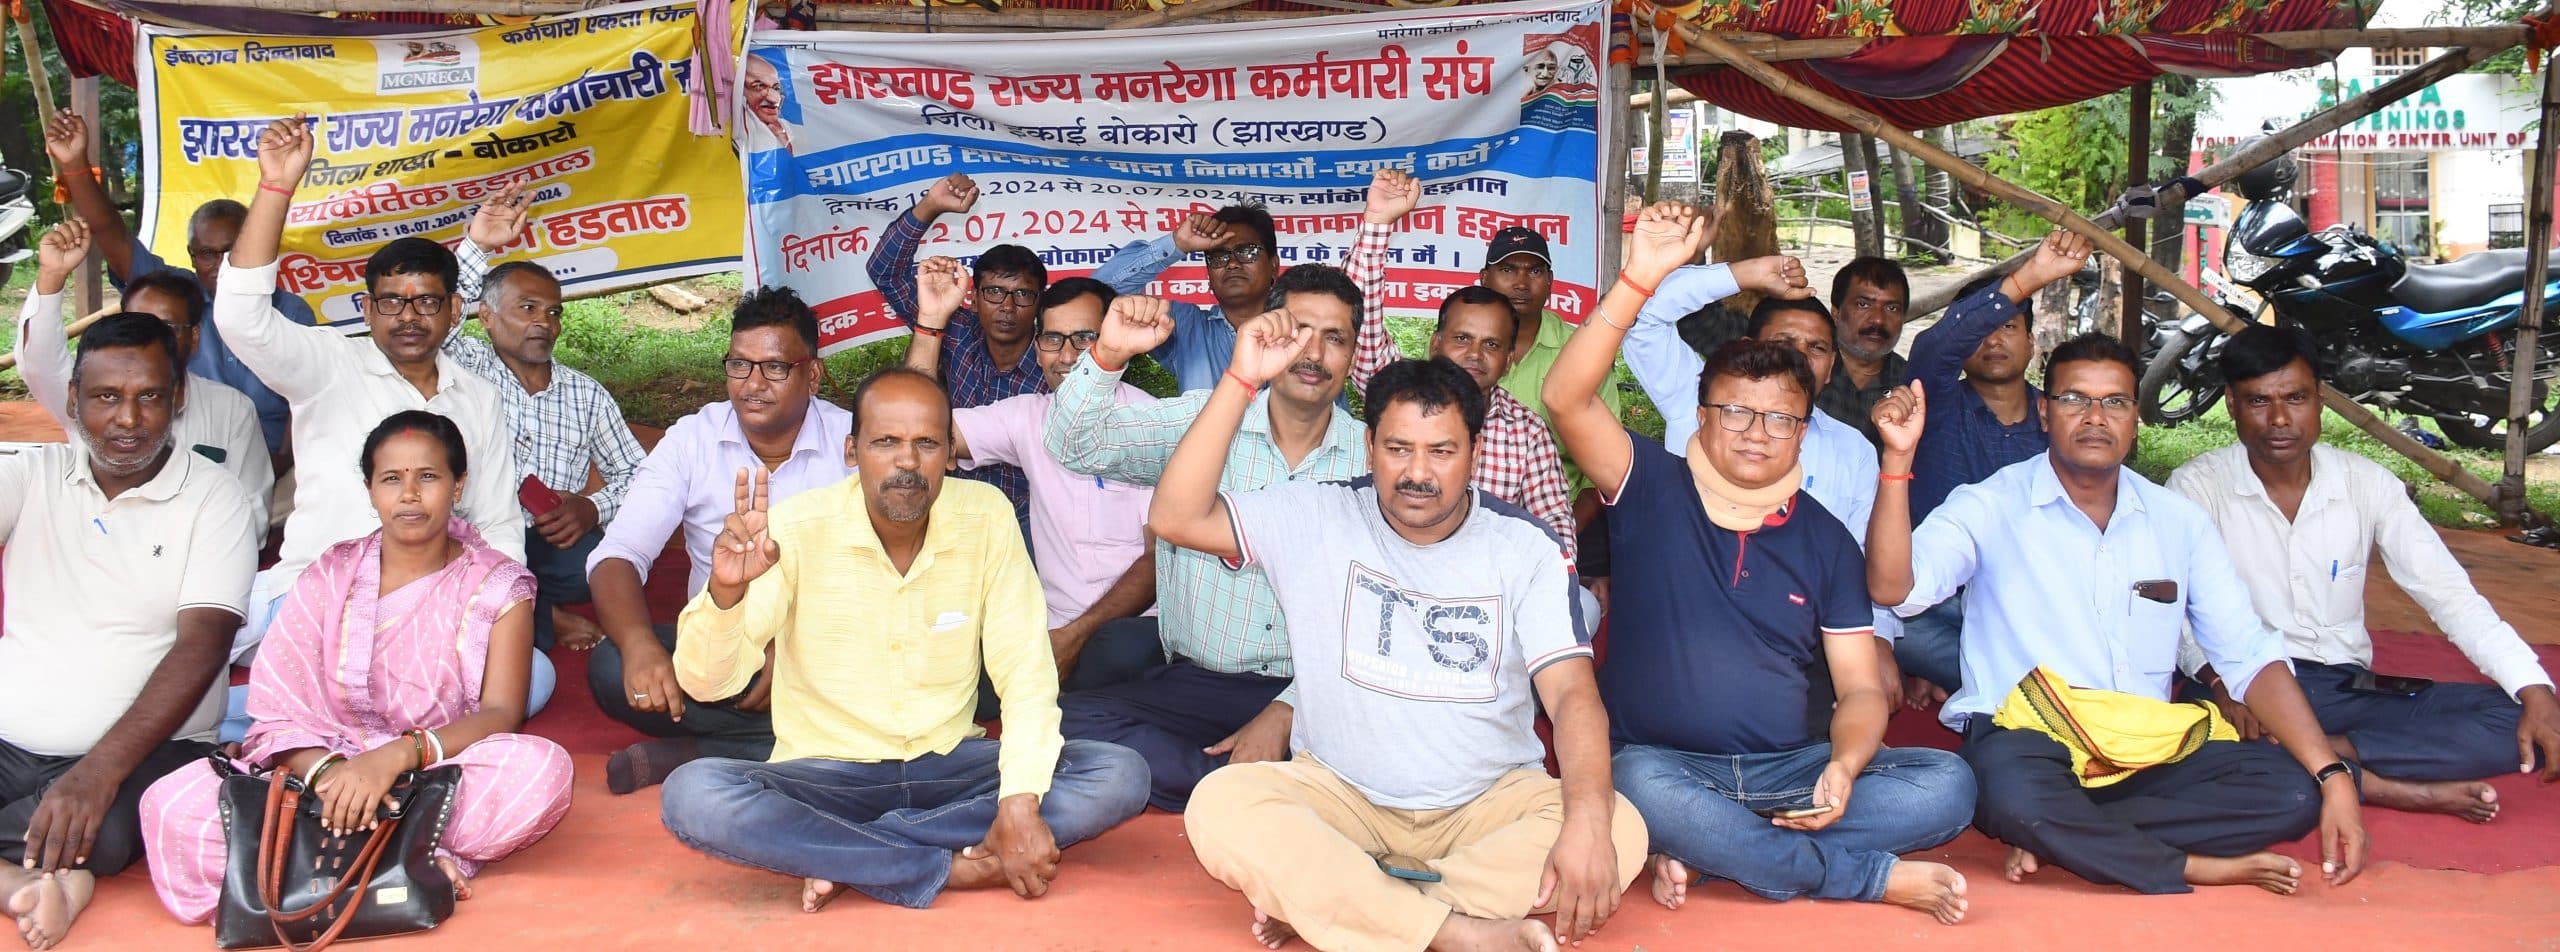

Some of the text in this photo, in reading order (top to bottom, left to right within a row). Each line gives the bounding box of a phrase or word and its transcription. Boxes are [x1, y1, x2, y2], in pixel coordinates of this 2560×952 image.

[383, 68, 473, 88] MGNREGA
[808, 63, 975, 109] झारखण्ड
[985, 73, 1082, 107] राज्य
[1091, 61, 1237, 103] मनरेगा
[1247, 44, 1411, 100] कर्मचारी
[1422, 39, 1495, 100] संघ
[327, 111, 403, 151] राज्य
[409, 90, 518, 143] मनरेगा
[922, 104, 1387, 148] जिला इकाई बोकारो (झारखण्ड)
[303, 158, 371, 187] जिला
[374, 149, 440, 176] शाखा
[471, 121, 577, 159] बोकारो
[2460, 132, 2496, 146] UNIT
[805, 144, 952, 188] झारखण्ड
[1059, 178, 1084, 193] से
[1091, 183, 1244, 201] 20.07.2024
[1248, 192, 1294, 205] तक
[326, 227, 377, 246] दिनांक
[395, 211, 467, 235] 18.07.2024
[781, 225, 870, 273] दिनांक
[918, 209, 1110, 244] 2.07.2024
[1120, 200, 1149, 233] से
[1037, 245, 1121, 266] बोकारो
[1306, 243, 1331, 261] के
[1411, 244, 1438, 264] में
